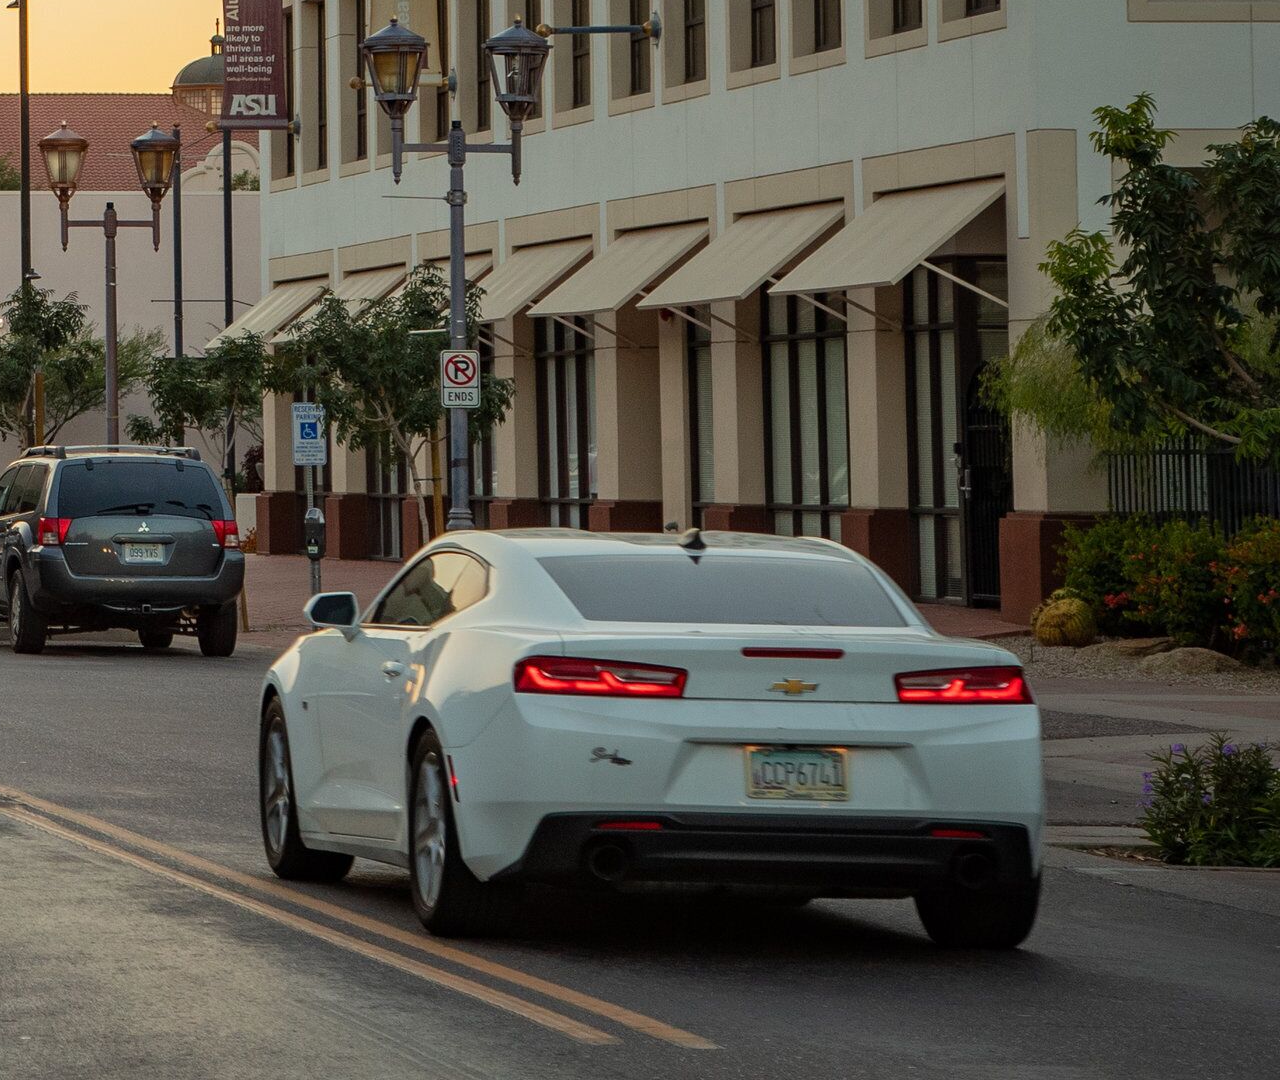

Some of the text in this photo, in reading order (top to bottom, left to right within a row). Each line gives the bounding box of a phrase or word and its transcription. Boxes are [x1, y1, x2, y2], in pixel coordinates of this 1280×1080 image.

[226, 34, 249, 44] likely
[226, 44, 262, 52] thrive in
[226, 54, 238, 62] all
[265, 54, 275, 62] of
[226, 64, 272, 74] well-being
[229, 94, 277, 116] ASU
[448, 391, 474, 402] ENDS
